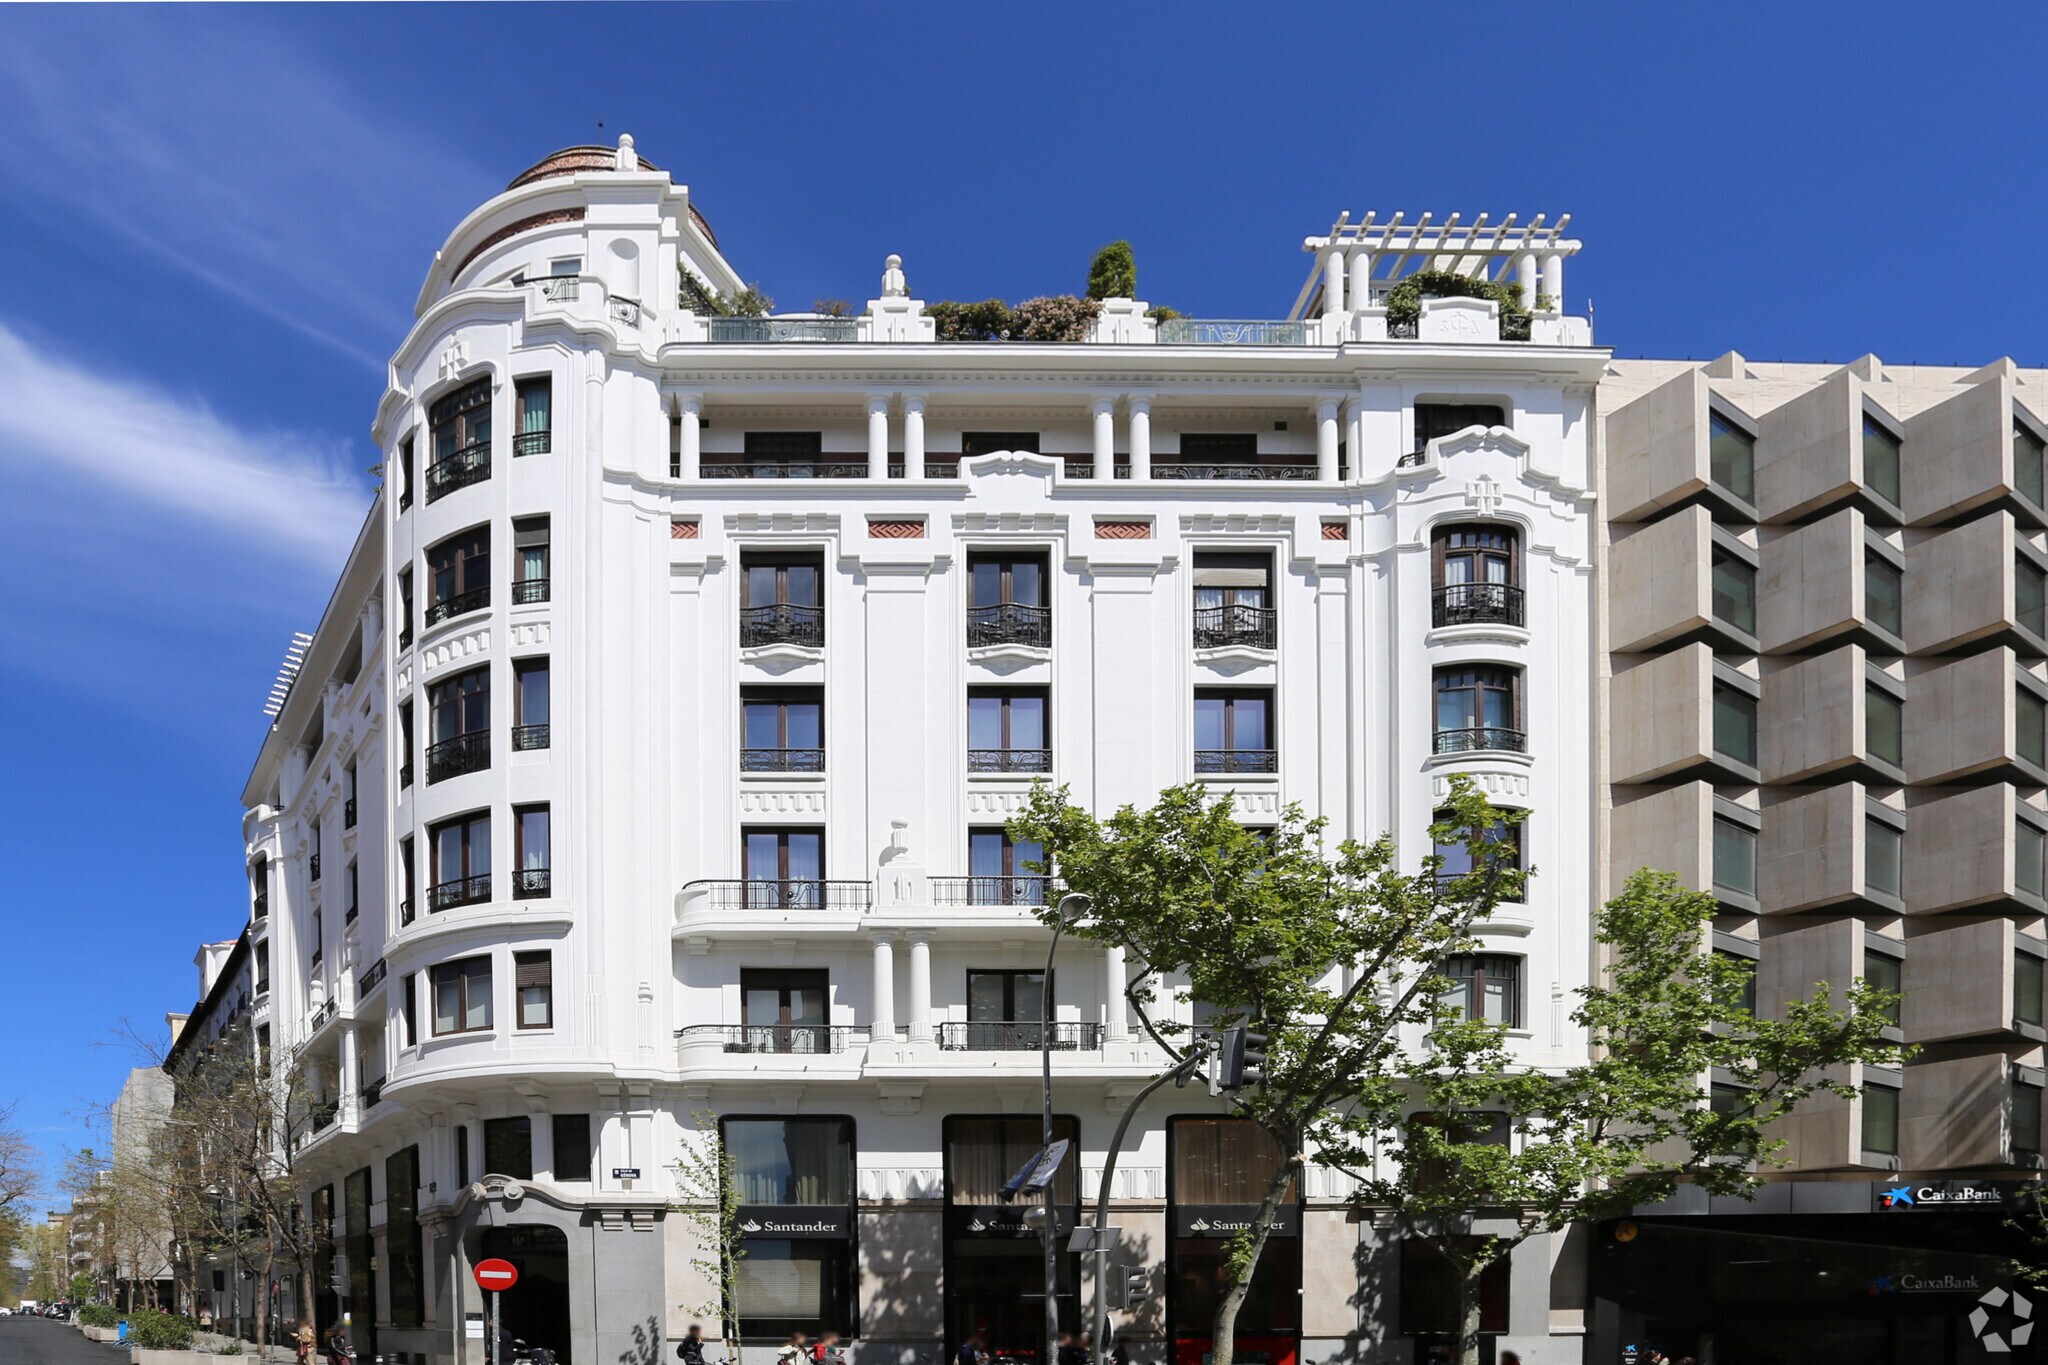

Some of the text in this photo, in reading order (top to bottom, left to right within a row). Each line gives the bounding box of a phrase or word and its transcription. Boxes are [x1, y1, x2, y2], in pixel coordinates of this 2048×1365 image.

[1917, 1187, 2002, 1201] CaixaBank
[764, 1221, 837, 1232] Santander
[989, 1220, 1062, 1231] Santar
[1212, 1220, 1285, 1231] Santaer
[1901, 1274, 1980, 1290] CaixaBank
